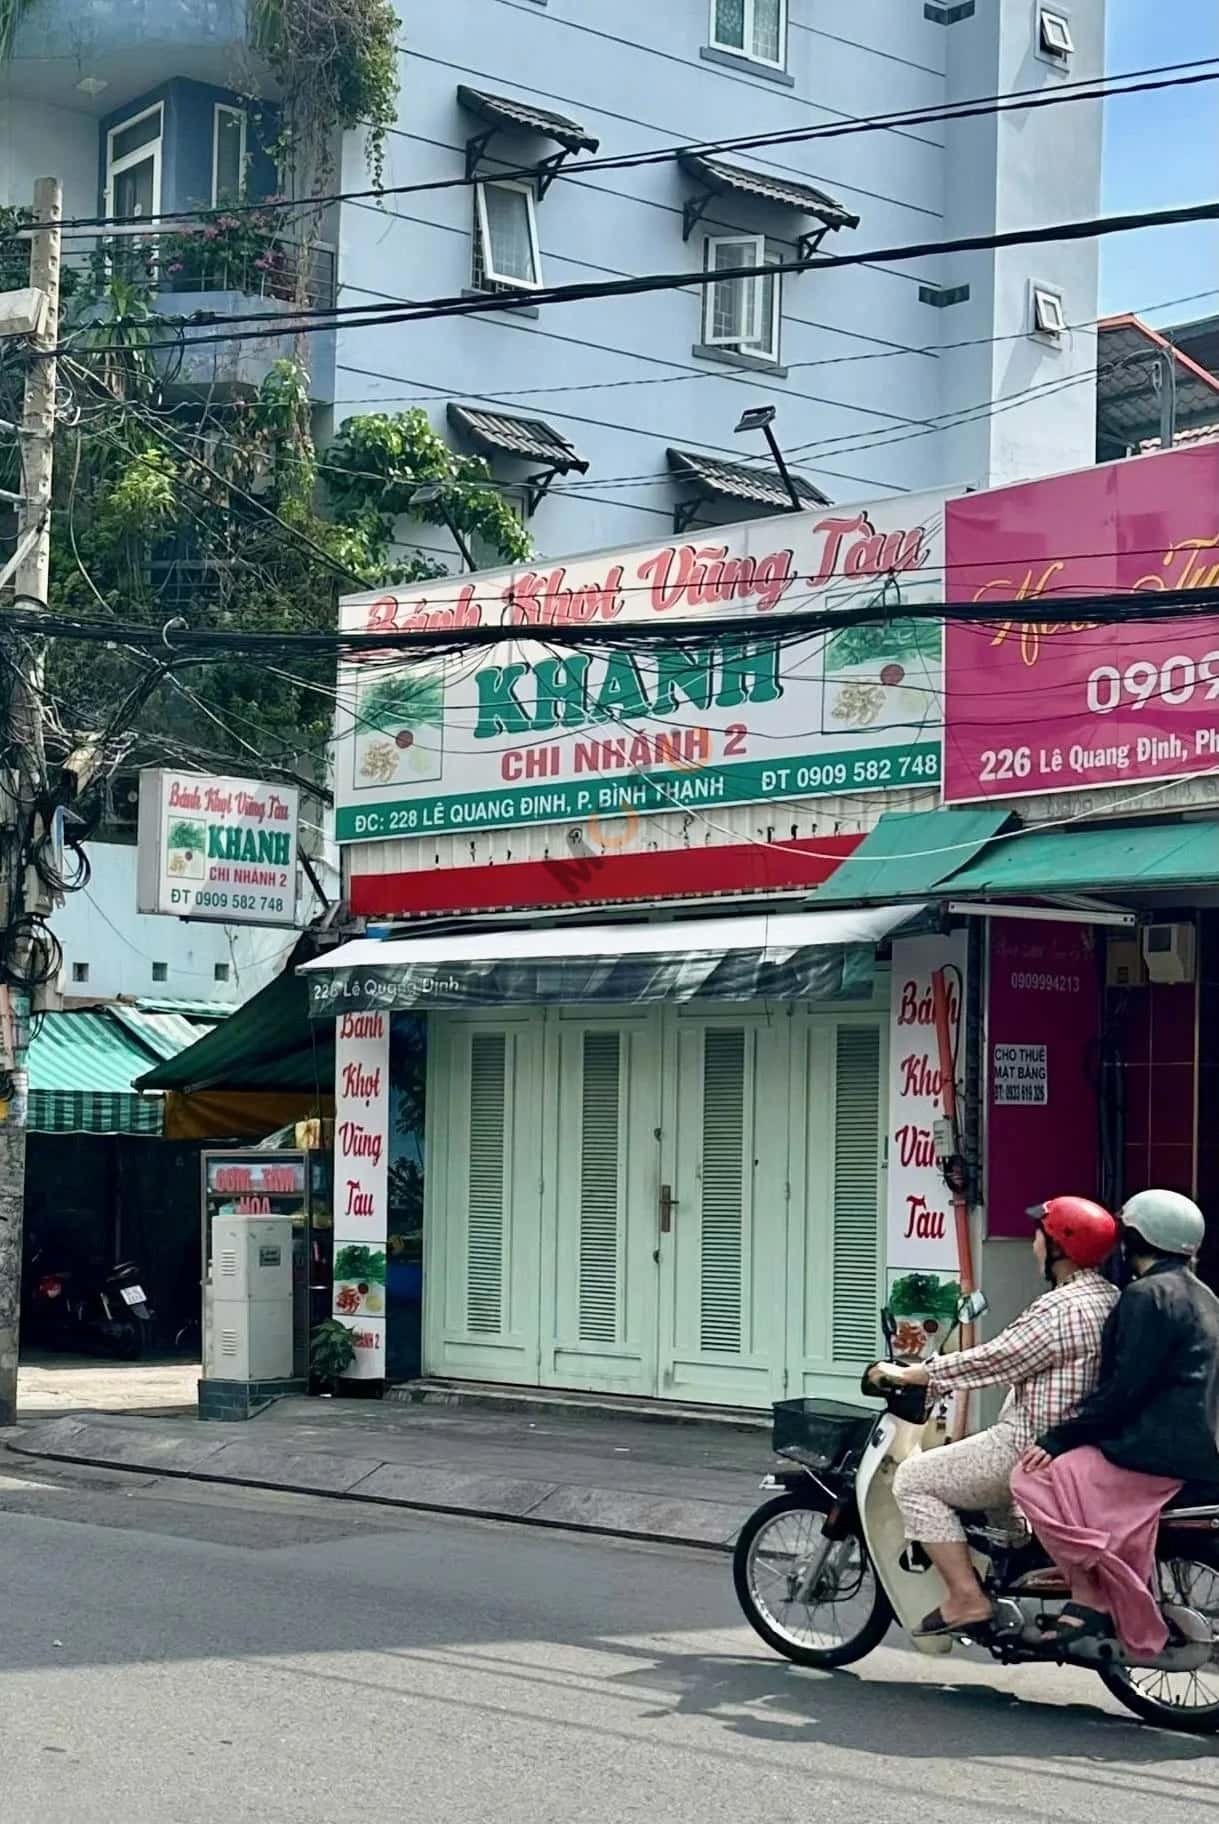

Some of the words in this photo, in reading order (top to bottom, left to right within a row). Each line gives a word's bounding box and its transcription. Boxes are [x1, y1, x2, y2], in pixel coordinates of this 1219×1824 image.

[637, 544, 797, 612] Vũng
[806, 510, 930, 587] Tàu
[474, 635, 784, 738] KHANH
[501, 746, 560, 782] CHI
[574, 727, 710, 773] NHÁNH
[723, 723, 748, 756] 2
[761, 770, 790, 791] ĐT
[797, 764, 847, 788] 0909
[853, 759, 891, 782] 582
[900, 754, 938, 777] 748
[979, 747, 1031, 782] 226
[1040, 749, 1062, 773] Lê
[1069, 744, 1130, 771] Quang
[1137, 733, 1188, 765] Định,
[168, 782, 201, 809] Bánh
[355, 813, 385, 833] ĐC:
[389, 808, 417, 830] 228
[423, 802, 445, 825] LÊ
[450, 798, 515, 823] QUANG
[520, 793, 571, 818] ĐỊNH,
[577, 791, 592, 809] P.
[601, 783, 646, 808] BÌNH
[655, 776, 724, 804] THẠNH
[208, 824, 291, 866] KHANH
[209, 866, 230, 881] CHI
[234, 868, 276, 886] NHÁNH
[279, 873, 287, 887] 2
[171, 889, 191, 904] ĐT
[196, 891, 228, 907] 0909
[232, 894, 256, 910] 582
[260, 896, 284, 912] 748
[342, 1063, 380, 1107] Khọt
[900, 1054, 945, 1107] Khọ
[338, 1121, 383, 1167] Vũng
[375, 1333, 380, 1350] 2
